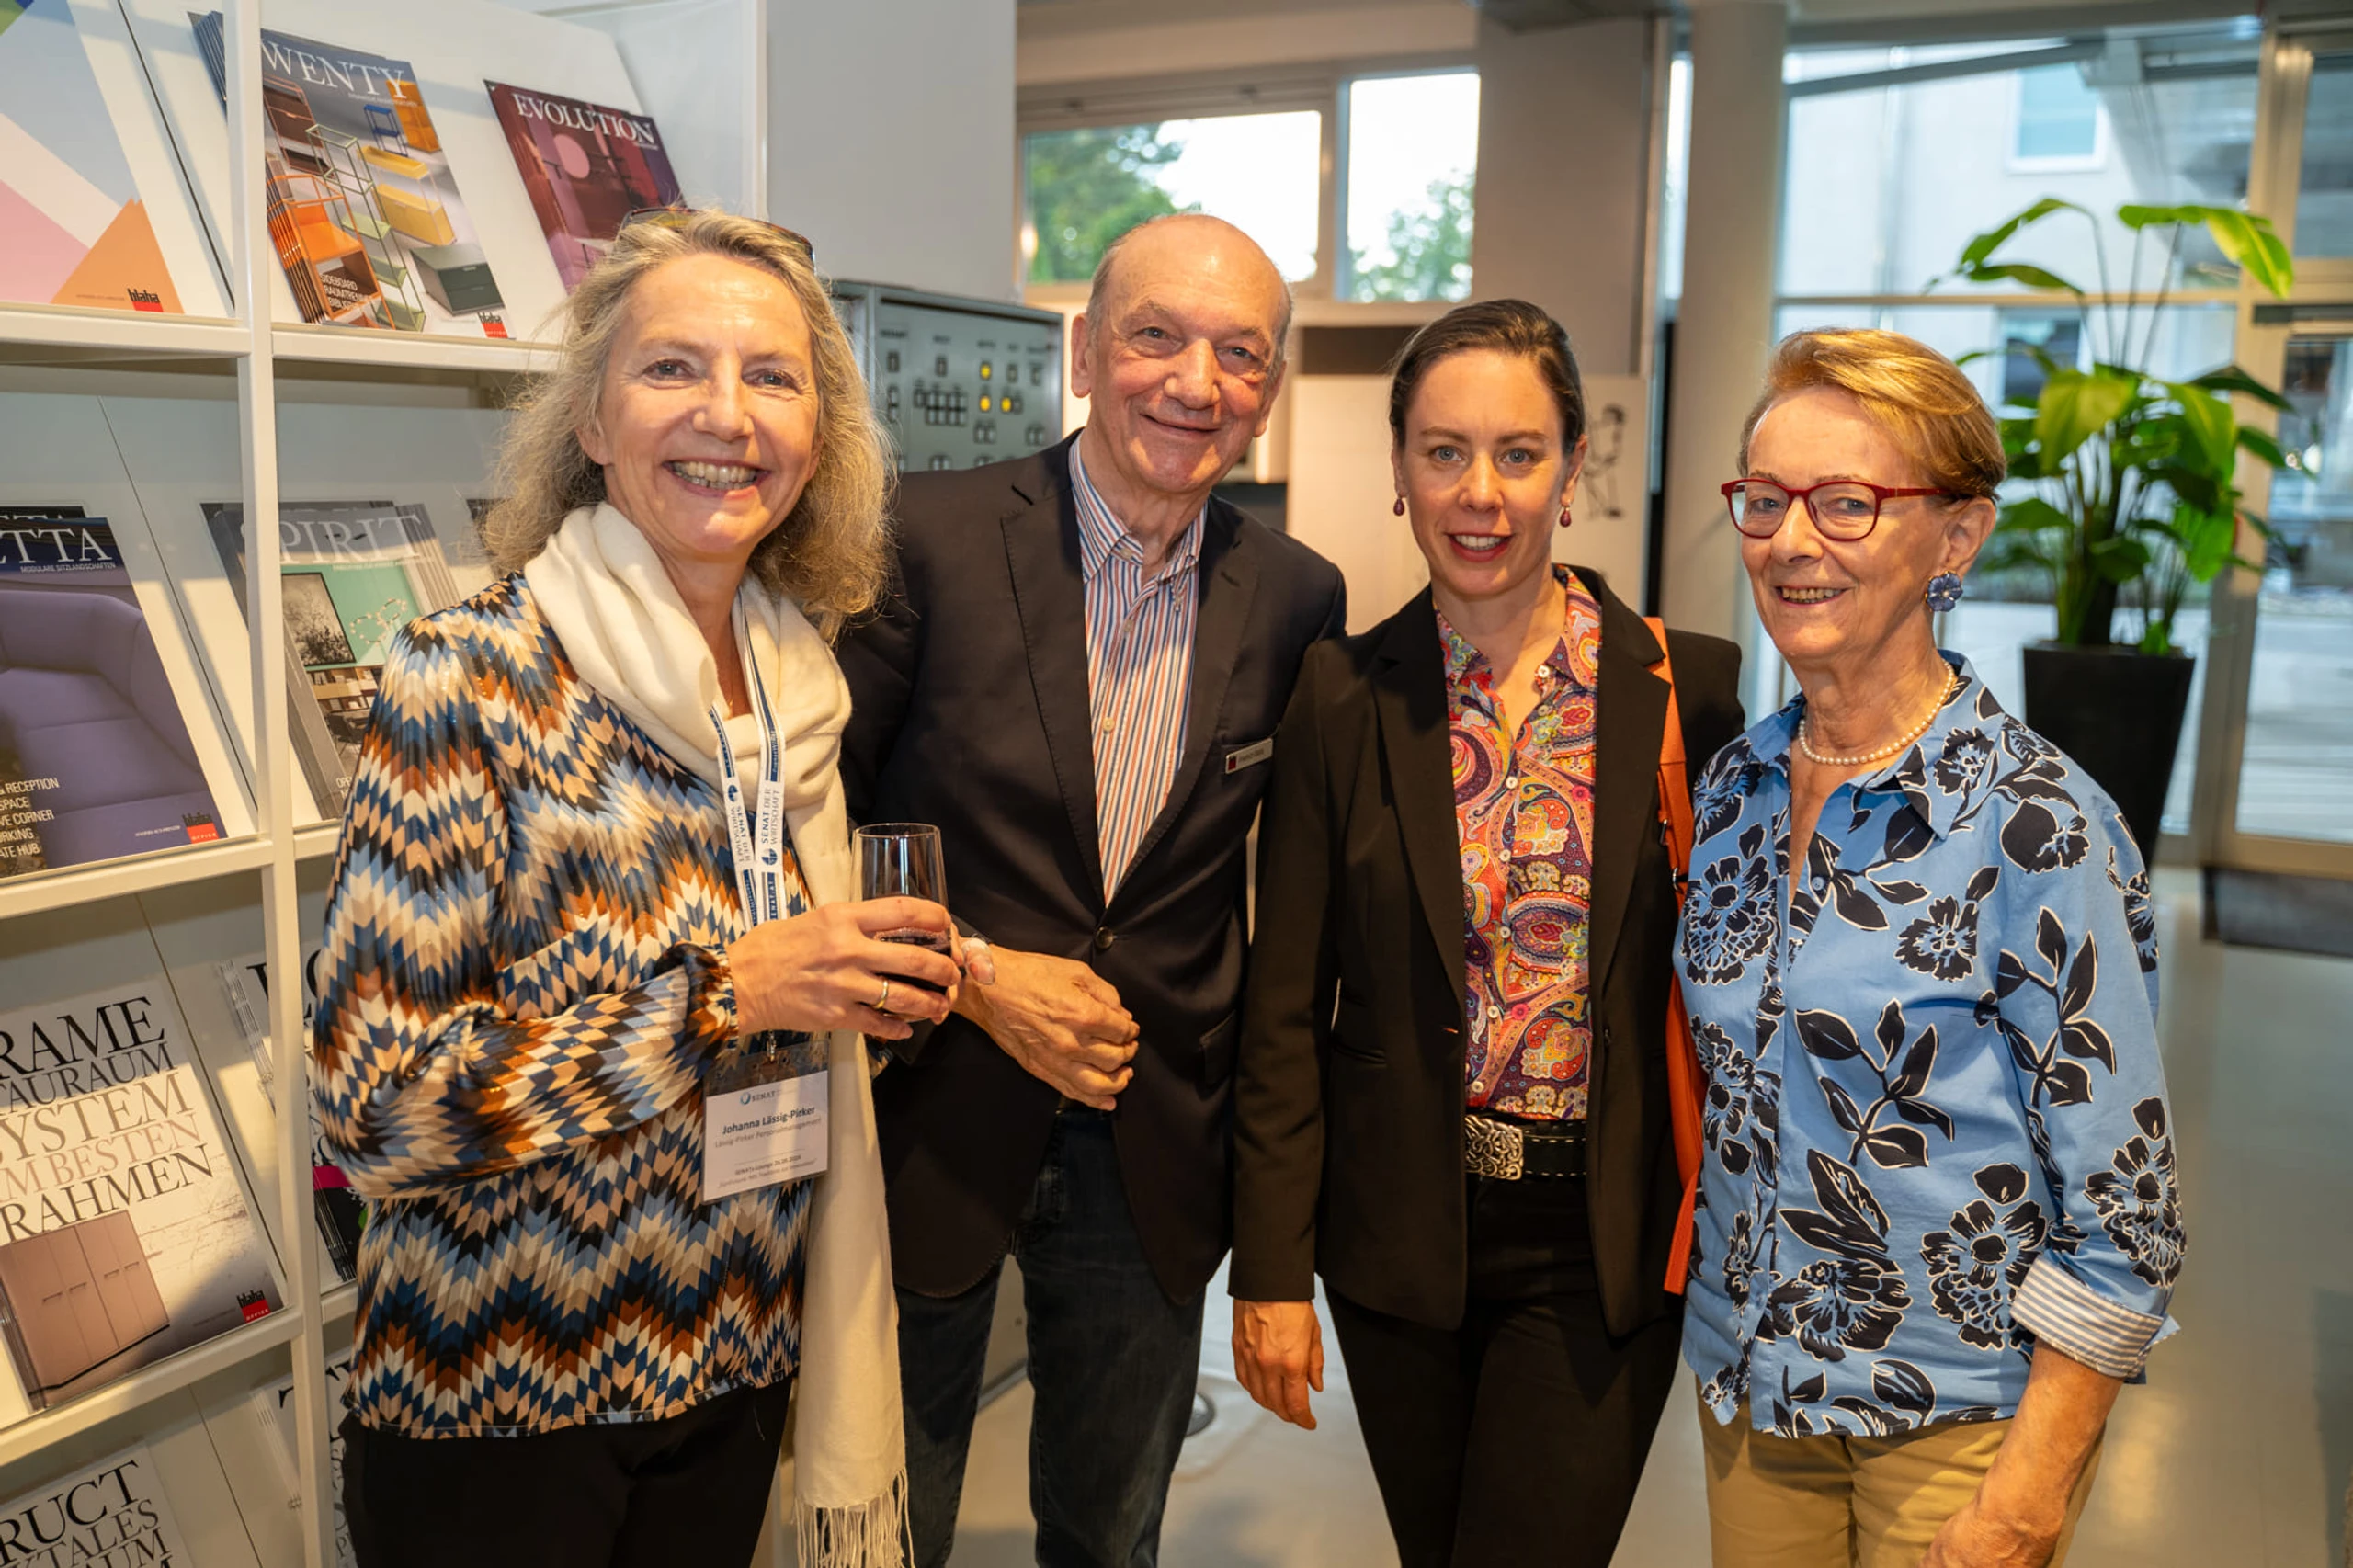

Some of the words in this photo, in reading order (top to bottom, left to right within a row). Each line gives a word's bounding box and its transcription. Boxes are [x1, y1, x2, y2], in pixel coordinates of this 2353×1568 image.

[512, 93, 656, 144] EVOLUTION
[0, 528, 113, 564] TTA
[241, 515, 422, 563] PIRIT
[5, 778, 60, 793] RECEPTION
[12, 809, 55, 825] CORNER
[761, 812, 770, 844] SENAT
[770, 790, 780, 845] WIRTSCHAFT
[17, 843, 40, 856] HUB
[0, 996, 165, 1079] RAME
[0, 1072, 193, 1165] YSTEM
[722, 1119, 761, 1135] Johanna
[762, 1107, 816, 1127] Lässig-Pirker
[44, 1112, 201, 1187] BESTEN
[0, 1142, 213, 1243] RAHMEN
[0, 1460, 139, 1565] RUCT
[0, 1498, 160, 1568] TALES
